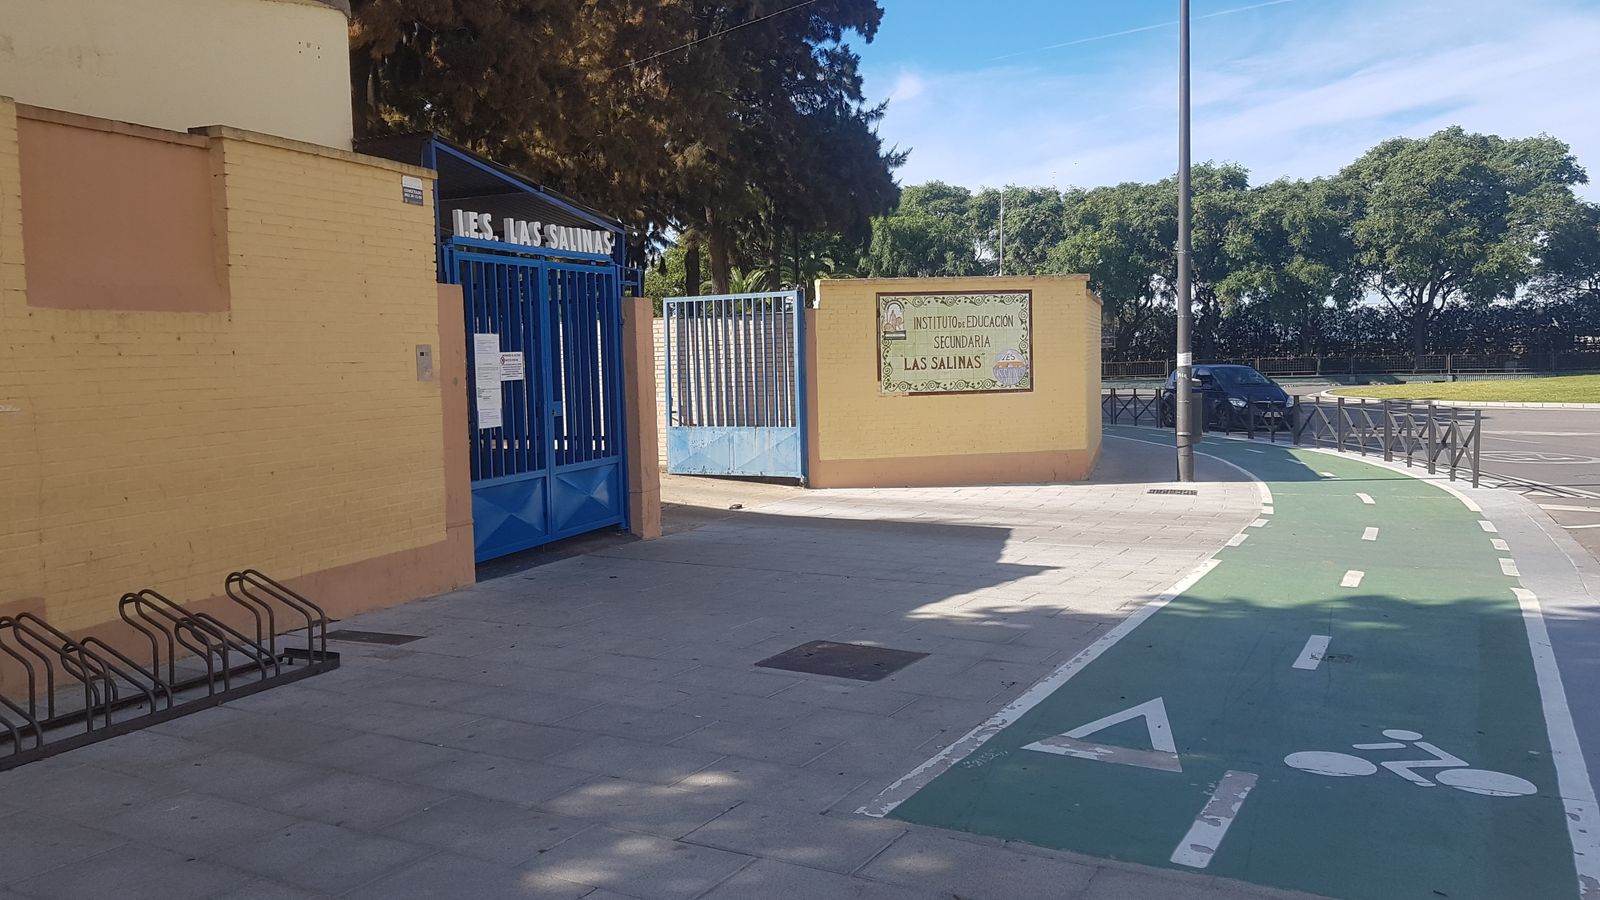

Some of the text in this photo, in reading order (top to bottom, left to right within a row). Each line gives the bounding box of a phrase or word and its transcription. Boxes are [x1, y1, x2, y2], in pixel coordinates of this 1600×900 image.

[452, 209, 611, 255] I.E.S. LAS SALINAS
[913, 315, 958, 330] INSTITUTO
[966, 313, 1014, 328] EDUCACIÓN
[934, 335, 991, 349] SECUNDARIA
